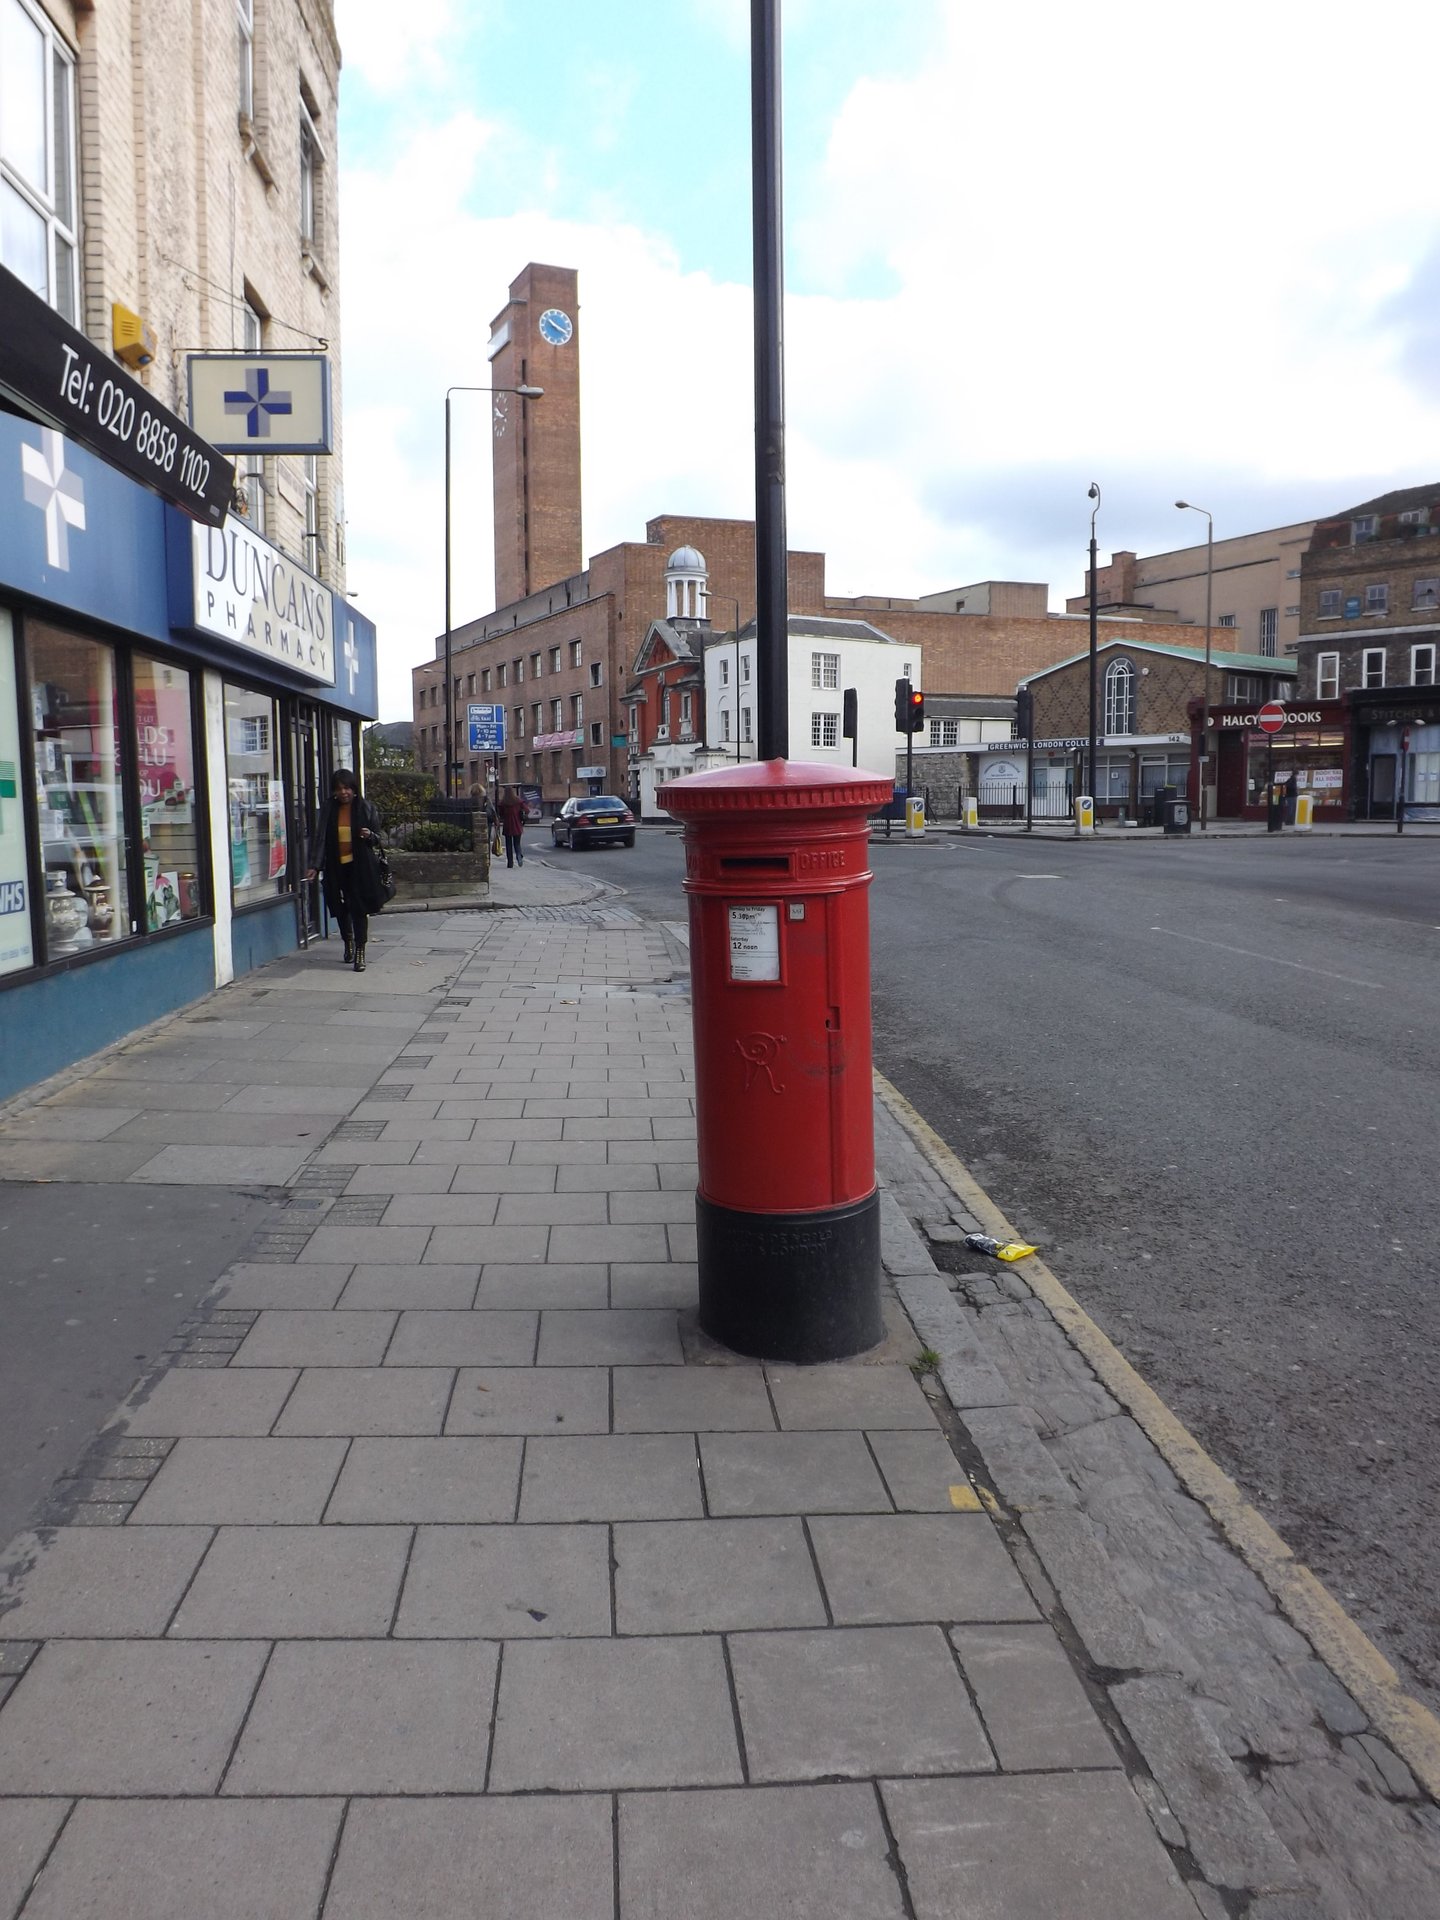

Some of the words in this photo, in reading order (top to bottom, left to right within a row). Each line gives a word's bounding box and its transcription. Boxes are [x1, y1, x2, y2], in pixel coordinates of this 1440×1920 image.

[60, 343, 94, 414] Tel:
[97, 379, 136, 441] 020
[136, 411, 178, 473] 8858
[180, 444, 210, 499] 1102
[206, 527, 325, 641] DUNCANS
[207, 590, 326, 671] PHARMACY
[1222, 714, 1259, 727] HALCY
[1033, 740, 1063, 749] LONDON
[1065, 738, 1101, 747] COLLEE
[801, 850, 845, 869] OFFICE
[732, 942, 742, 950] 12
